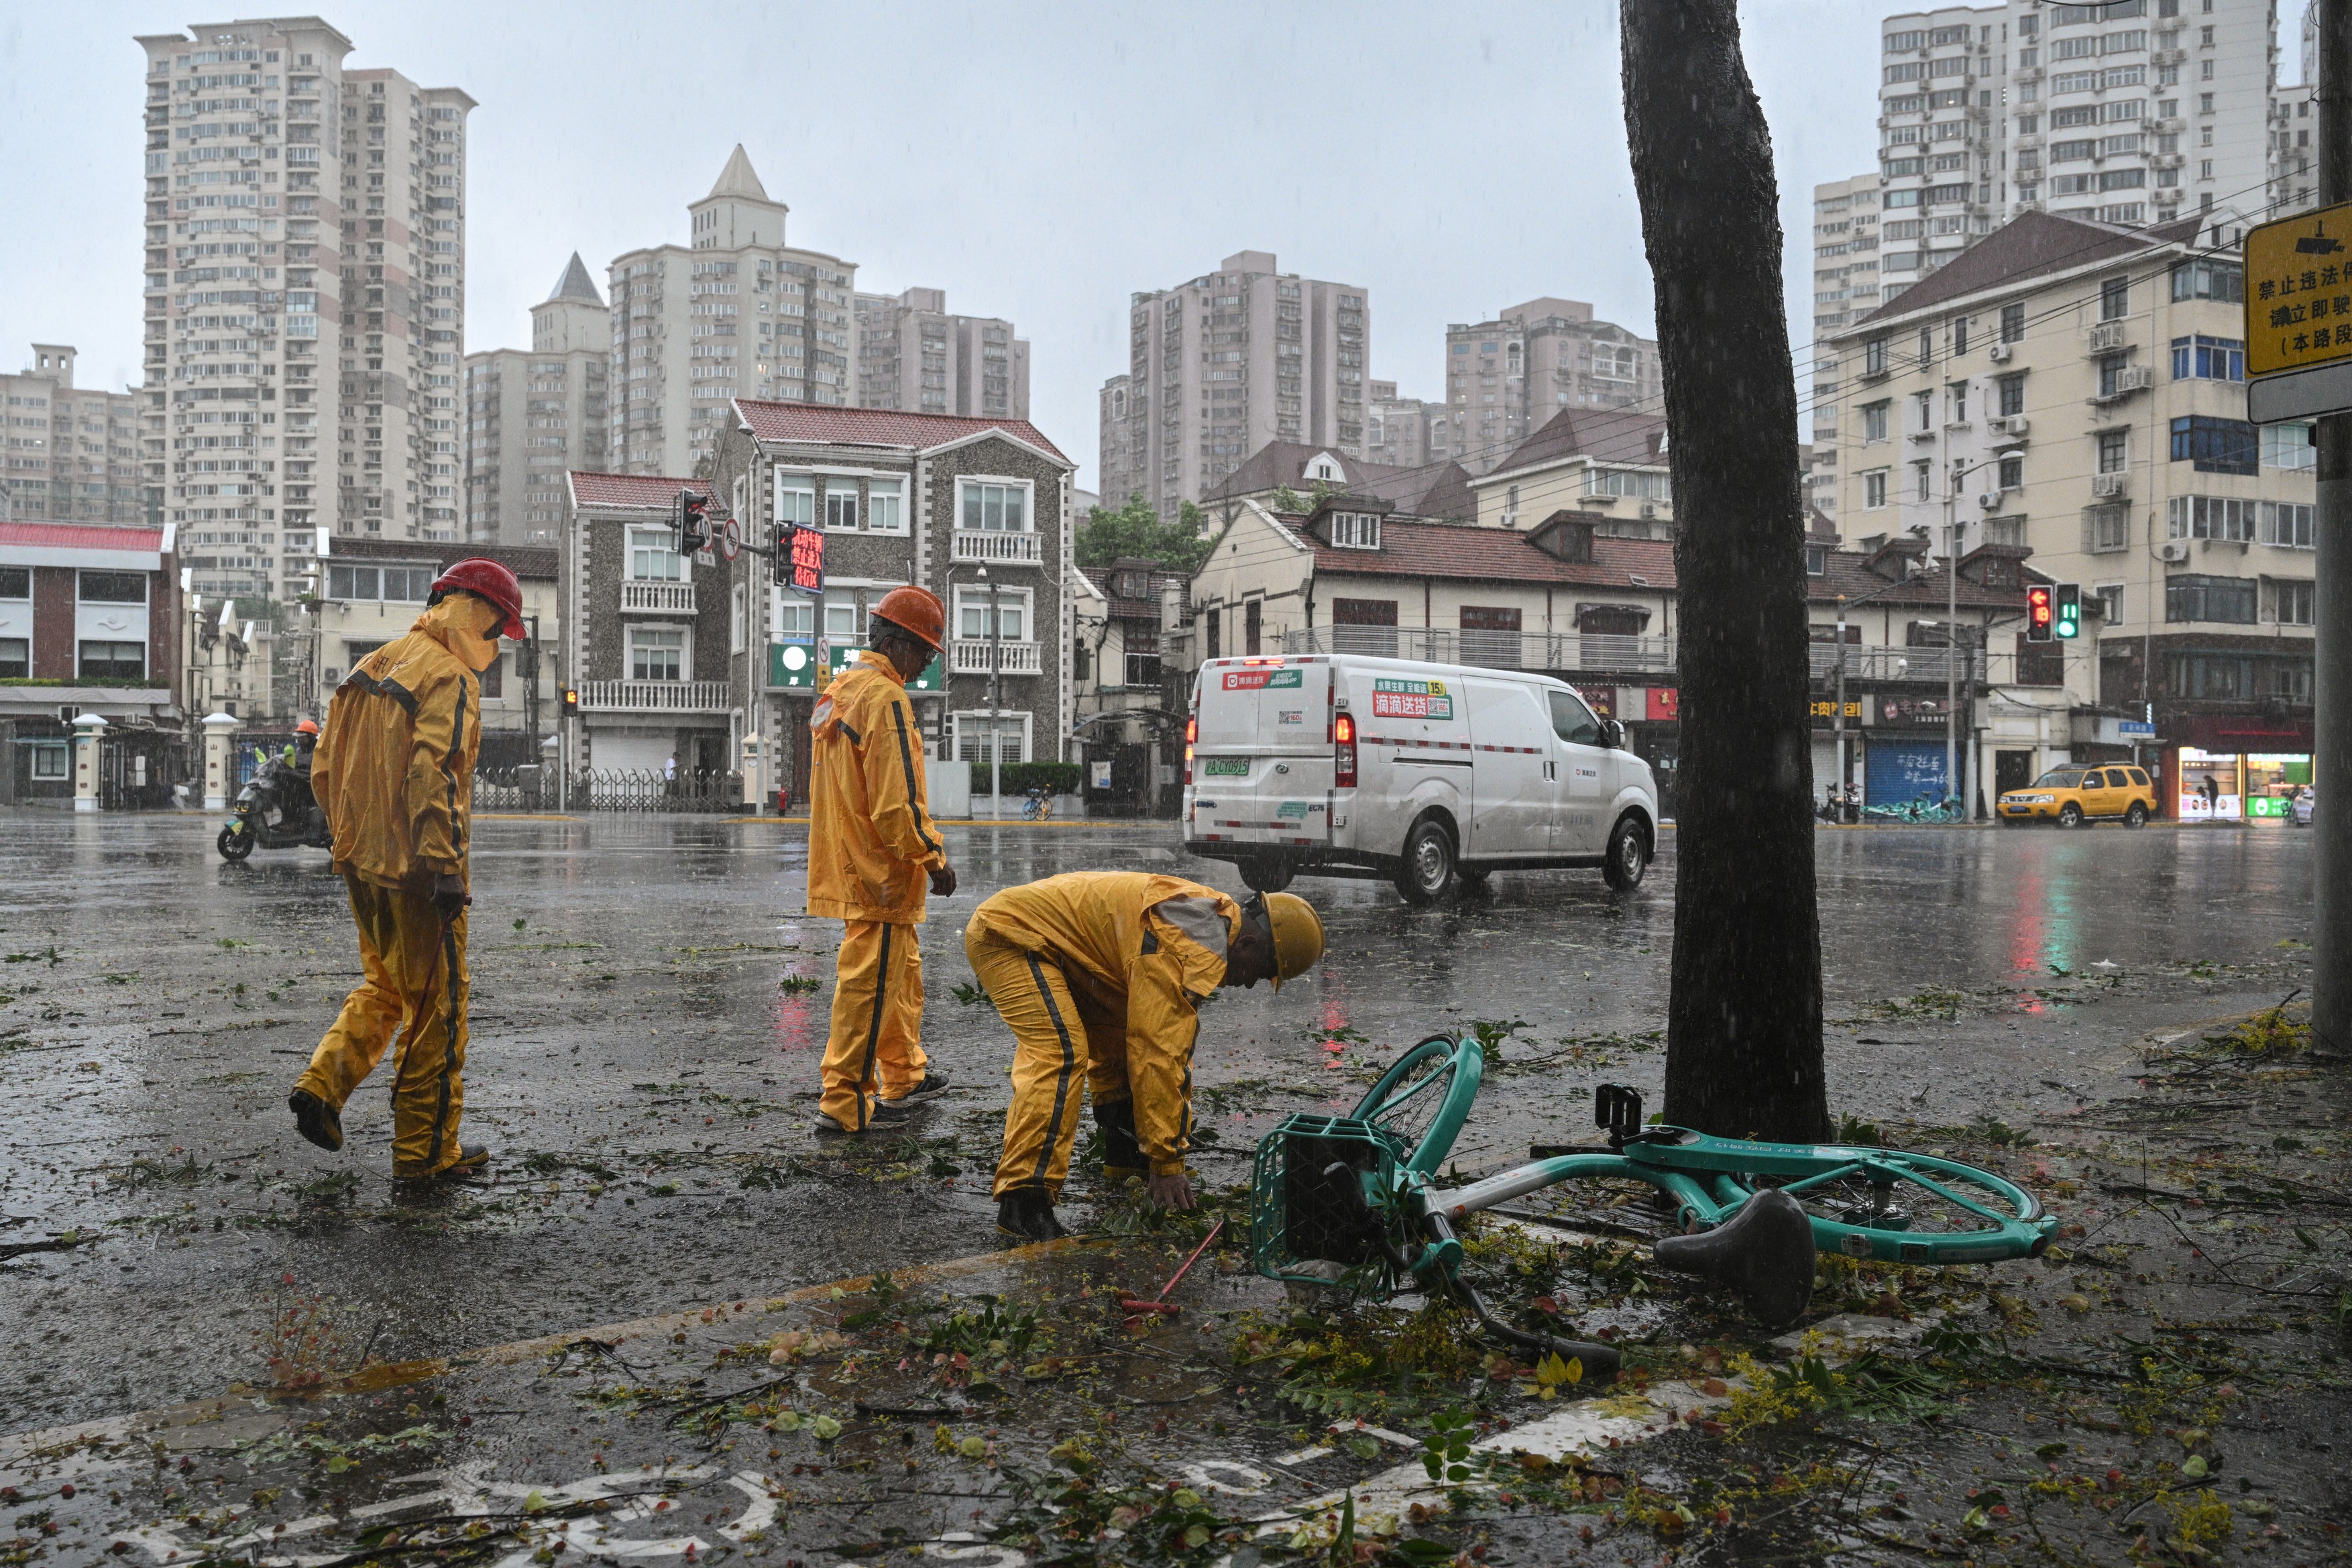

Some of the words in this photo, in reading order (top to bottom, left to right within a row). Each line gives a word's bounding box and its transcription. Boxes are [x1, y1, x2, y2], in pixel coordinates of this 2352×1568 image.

[792, 545, 822, 570] 禁止进入
[1239, 675, 1264, 685] 滴滴送货
[1378, 680, 1405, 692] 水果生鲜
[1407, 682, 1427, 693] 全能送
[1376, 693, 1426, 716] 滴滴送货
